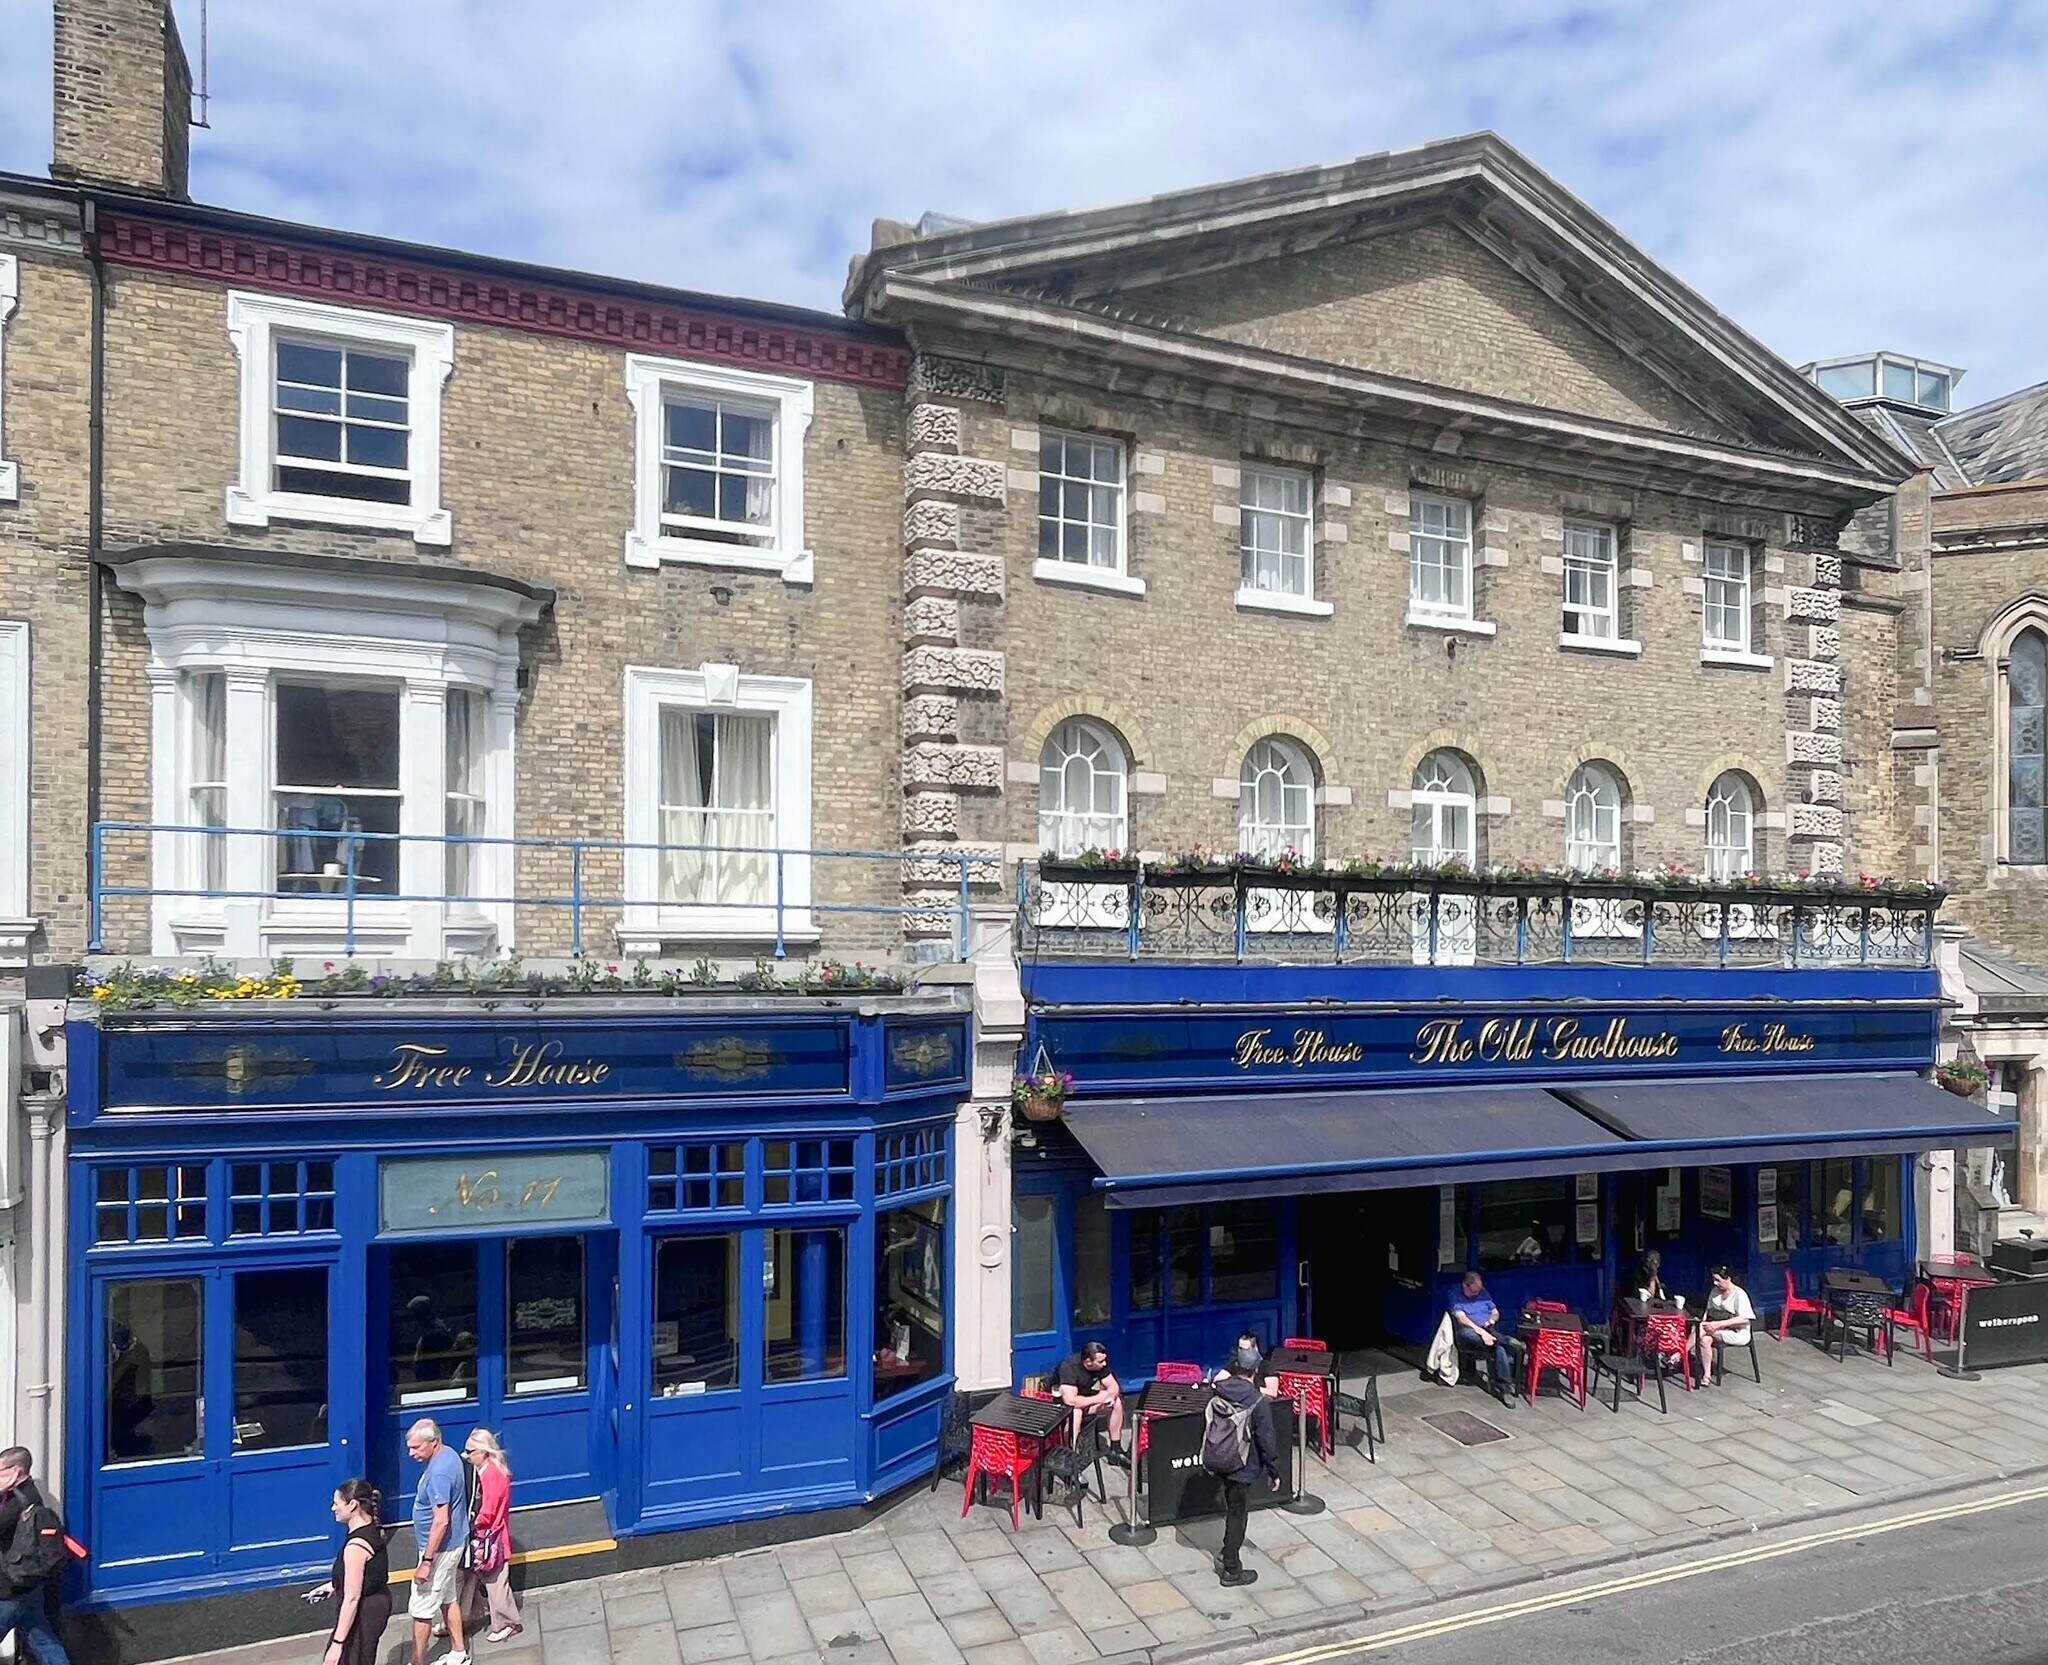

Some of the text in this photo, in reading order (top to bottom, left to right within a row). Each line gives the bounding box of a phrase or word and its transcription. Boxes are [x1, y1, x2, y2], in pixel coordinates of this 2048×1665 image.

[1230, 1028, 1363, 1069] Free House
[1408, 1015, 1679, 1064] The Old Gaolhouse
[1717, 1022, 1815, 1055] Free House
[373, 1035, 611, 1090] Free House
